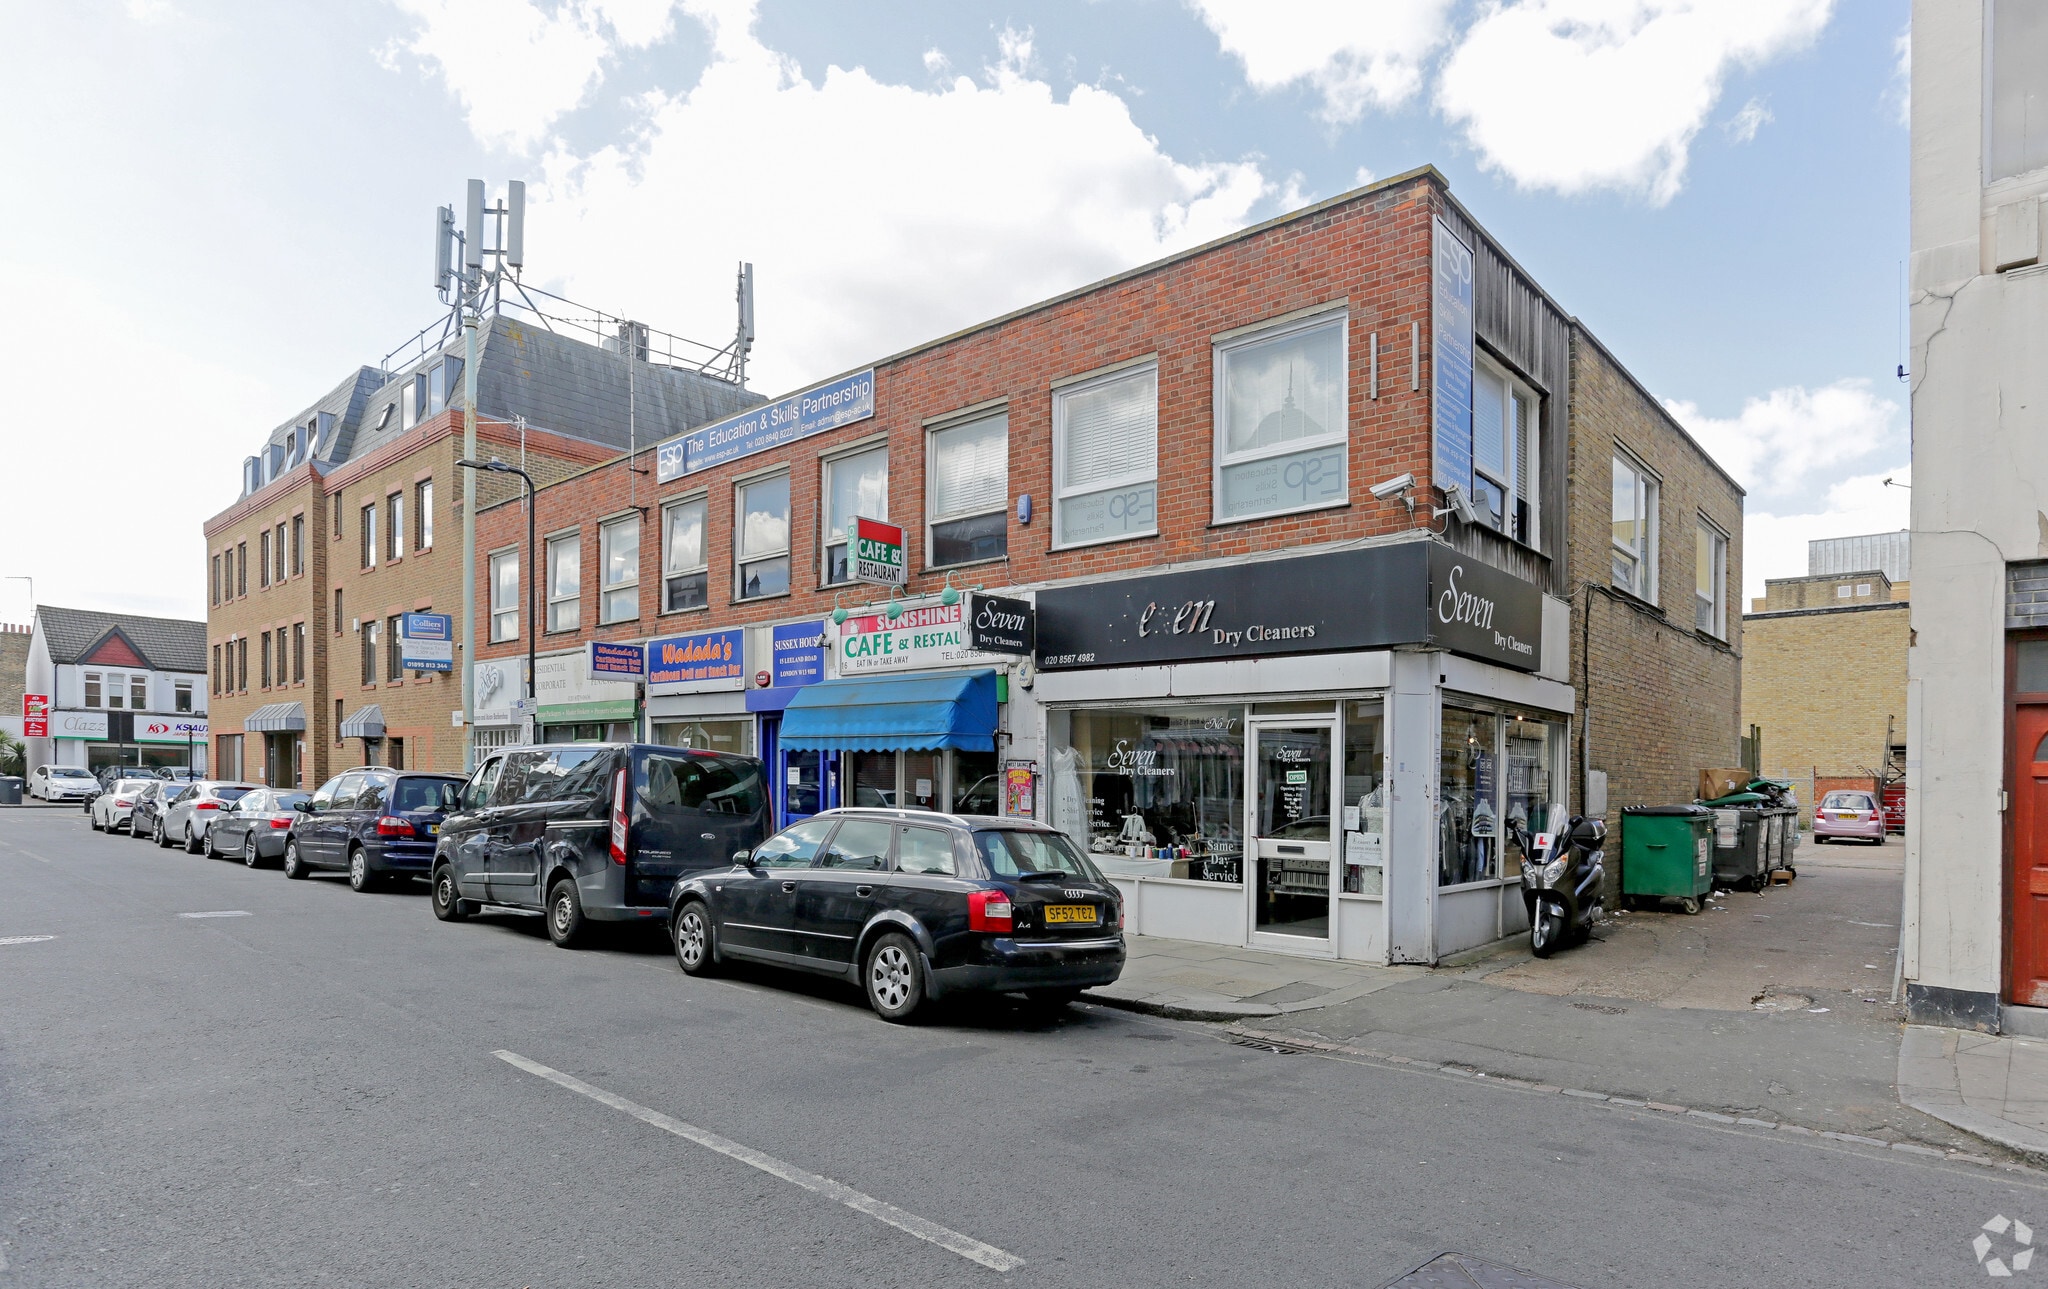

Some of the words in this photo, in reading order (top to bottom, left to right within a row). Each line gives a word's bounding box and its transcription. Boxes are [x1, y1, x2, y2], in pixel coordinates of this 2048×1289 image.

[1438, 280, 1468, 319] Education
[1438, 302, 1455, 327] Skills
[1438, 323, 1471, 362] Partnership
[686, 438, 704, 455] The
[709, 420, 757, 448] Education
[760, 413, 768, 430] &
[770, 404, 800, 426] Skills
[802, 379, 870, 416] Partnership
[754, 436, 765, 447] 020
[766, 431, 779, 444] 8840
[780, 427, 794, 438] 8222
[801, 422, 816, 432] Email:
[817, 402, 871, 427] admin@esp-ac.uk
[659, 444, 684, 477] Esp
[858, 538, 888, 562] CAFE
[890, 548, 902, 564] &
[858, 560, 900, 582] RESTAURANT
[1438, 565, 1494, 630] Seven
[876, 605, 960, 631] SUNSHINE
[976, 600, 1026, 631] Seven
[412, 619, 441, 628] Colliers
[980, 634, 993, 646] Dry
[994, 636, 1023, 648] Cleaners
[1212, 628, 1242, 648] Dry
[1246, 624, 1316, 643] Cleaners
[1494, 630, 1506, 650] Dry
[1508, 636, 1532, 656] Cleaners
[662, 635, 732, 664] Wadada's
[774, 638, 799, 651] SUSSEX
[844, 632, 893, 658] CAFE
[898, 638, 909, 650] &
[598, 646, 638, 658] Wadada's
[1044, 656, 1058, 664] 020
[1058, 654, 1076, 664] 8567
[1077, 652, 1095, 662] 4982
[595, 656, 628, 665] Caribbean
[784, 656, 805, 664] LEELAND
[856, 660, 866, 668] EAT
[867, 659, 873, 667] IN
[880, 658, 892, 666] TAKE
[894, 656, 909, 664] AWAY
[610, 664, 628, 672] Snack
[650, 670, 680, 682] Caribbean
[681, 668, 694, 680] Deli
[694, 666, 708, 678] and
[708, 664, 727, 678] Snack
[728, 664, 741, 676] Bar
[535, 680, 566, 691] CORPORATE
[64, 716, 106, 732] Clazz
[1204, 718, 1224, 730] No
[1226, 718, 1238, 730] 17
[1108, 740, 1156, 768] Seven
[1276, 745, 1302, 758] Seven
[1008, 770, 1030, 780] CIRCUS
[1119, 766, 1136, 778] Dry
[1137, 766, 1175, 776] Cleaners
[1208, 840, 1234, 852] Same
[1538, 836, 1548, 846] L
[1210, 854, 1230, 868] Day
[1202, 869, 1238, 882] Service
[1049, 907, 1074, 920] SF52
